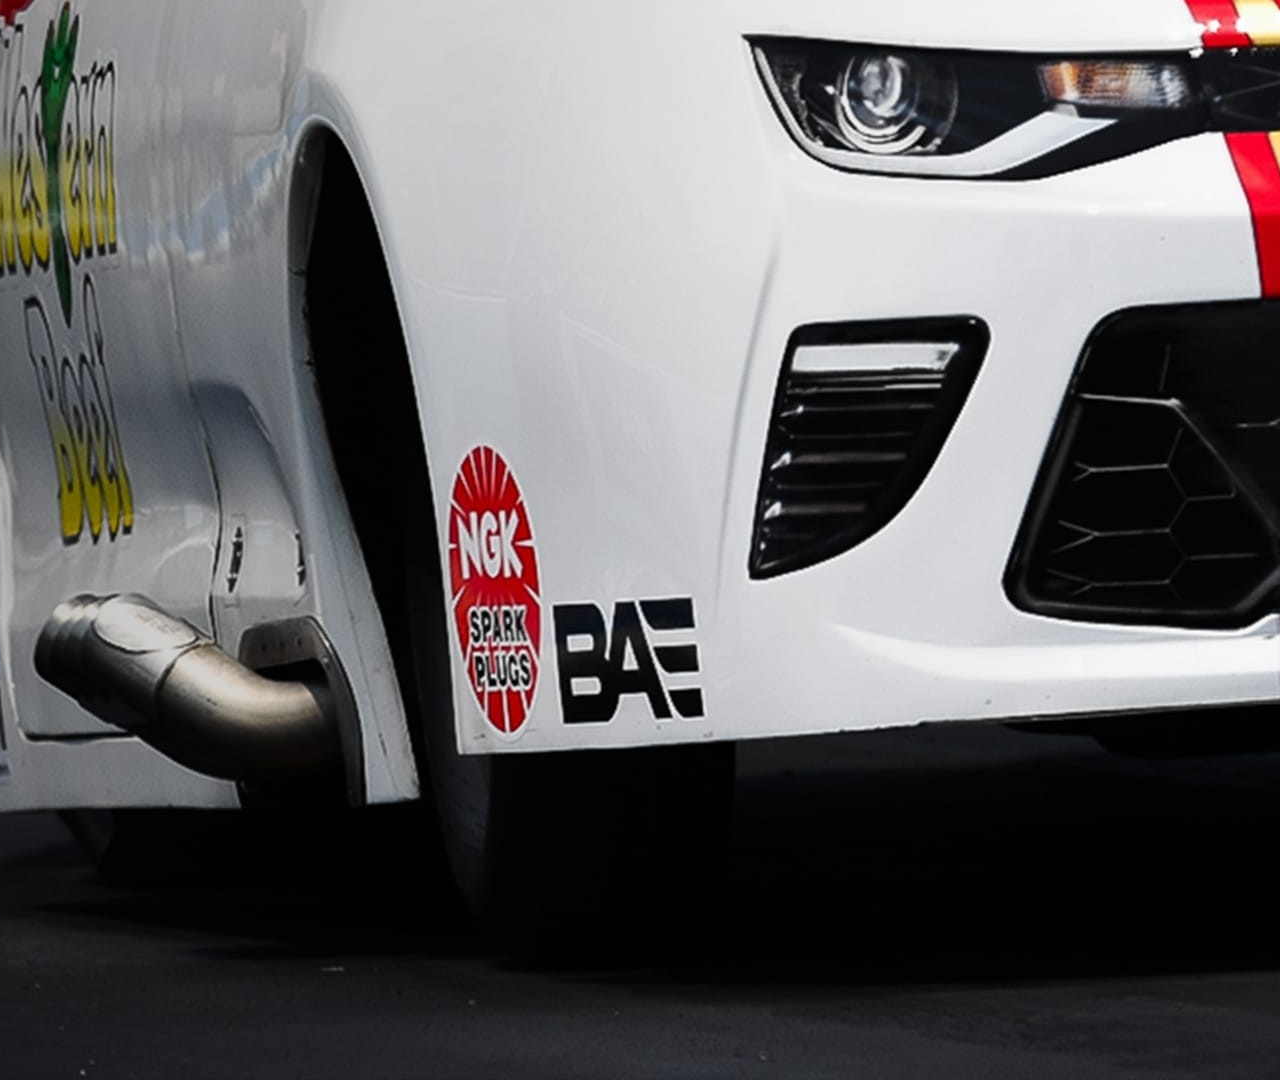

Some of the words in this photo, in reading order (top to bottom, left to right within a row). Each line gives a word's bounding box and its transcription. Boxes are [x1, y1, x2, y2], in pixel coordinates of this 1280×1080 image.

[456, 510, 525, 581] NGK
[468, 606, 529, 646] SPARK
[472, 651, 533, 691] PLUGS
[552, 596, 706, 726] BAE
